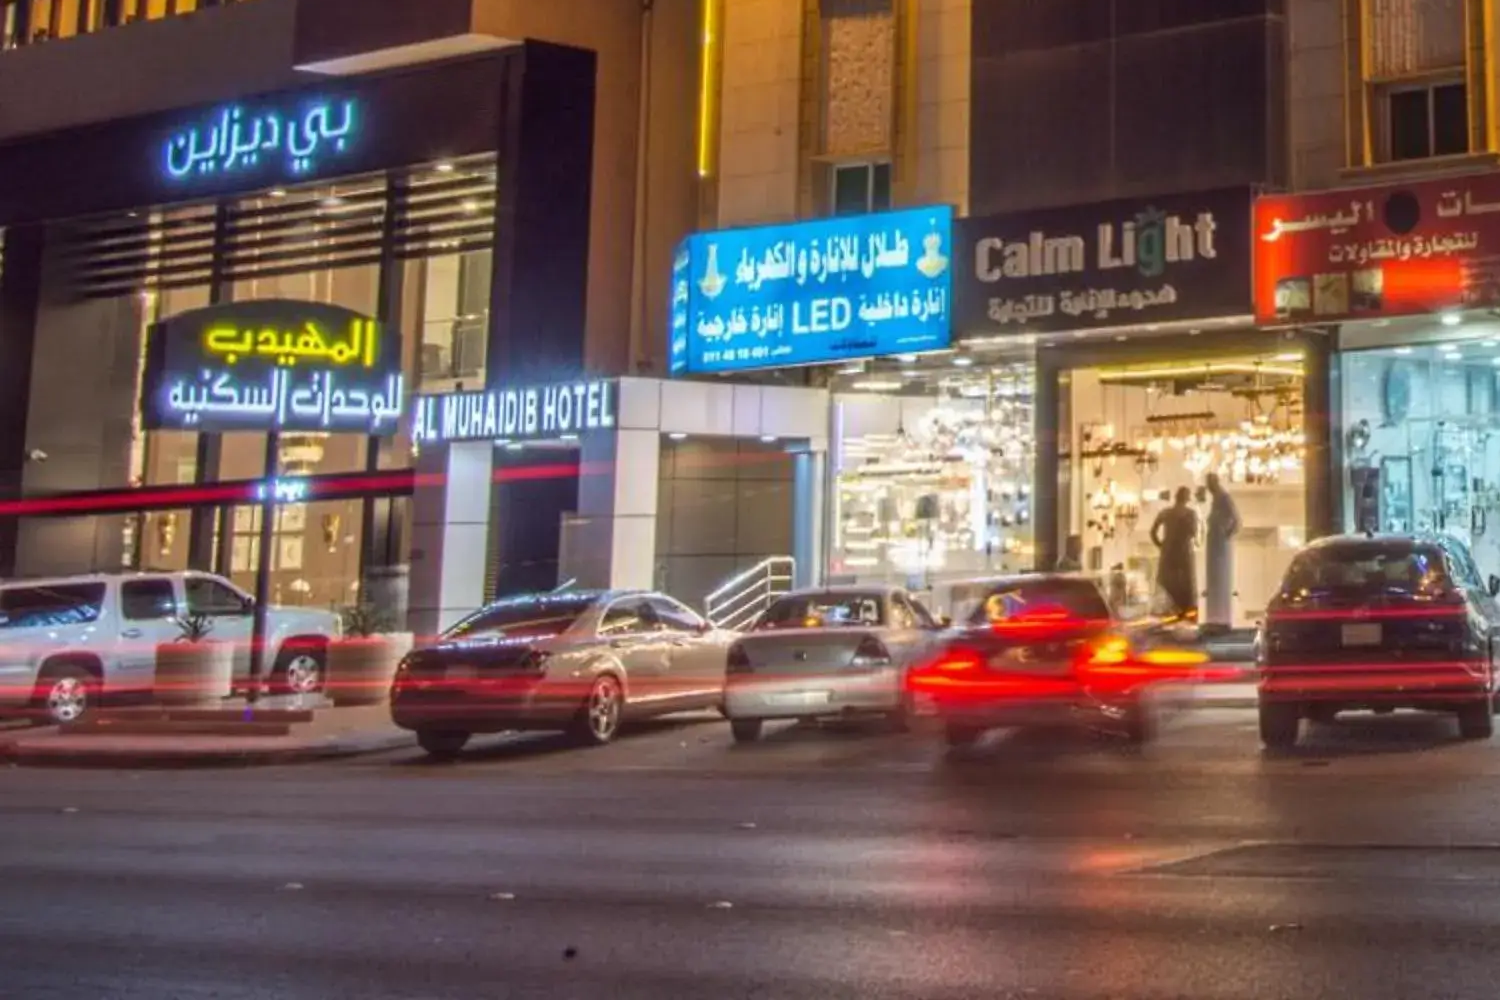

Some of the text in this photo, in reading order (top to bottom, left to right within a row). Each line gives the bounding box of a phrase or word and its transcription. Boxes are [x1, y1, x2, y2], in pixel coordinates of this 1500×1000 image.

[167, 100, 352, 176] بي ديزاين
[861, 229, 909, 280] طلال
[974, 210, 1217, 283] Calm Light
[1412, 230, 1479, 258] للتجارة
[205, 317, 377, 368] المهيدب
[791, 296, 851, 335] LED
[168, 368, 404, 428] للوحدات السكنيه
[411, 381, 615, 440] AL MUHAIDIB HOTEL
